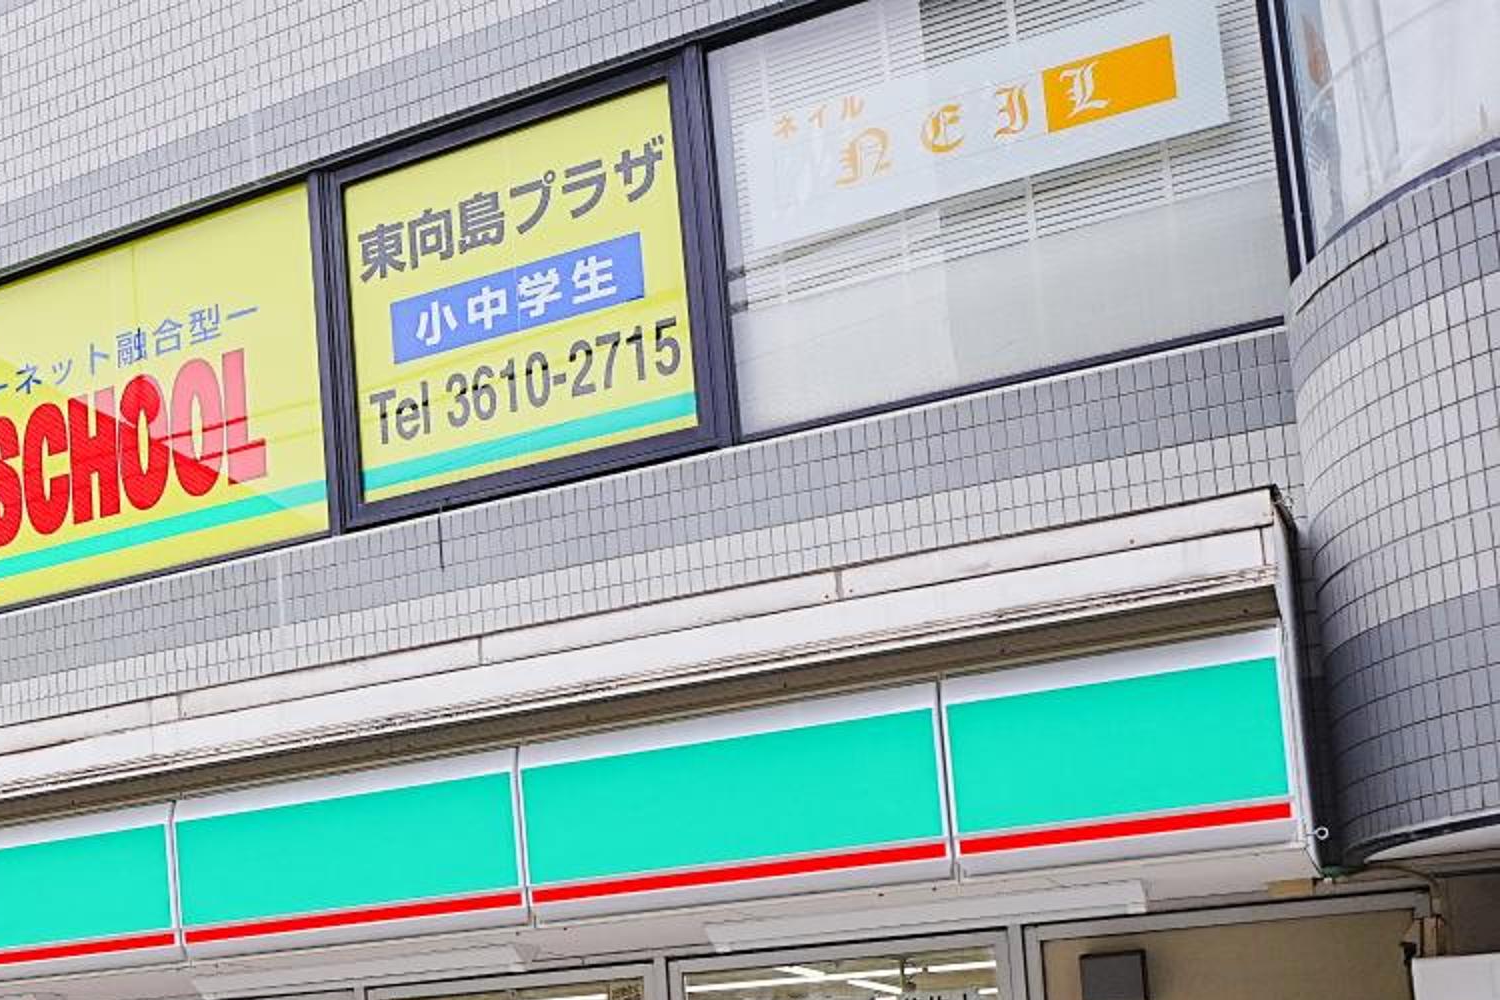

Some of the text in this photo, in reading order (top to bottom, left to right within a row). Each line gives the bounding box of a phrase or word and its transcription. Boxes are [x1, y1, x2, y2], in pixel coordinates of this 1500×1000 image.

[772, 95, 866, 140] ネイル
[357, 133, 665, 284] 東向島プラザ
[415, 255, 618, 347] 小中学生
[369, 316, 682, 445] Tel 3610-2715
